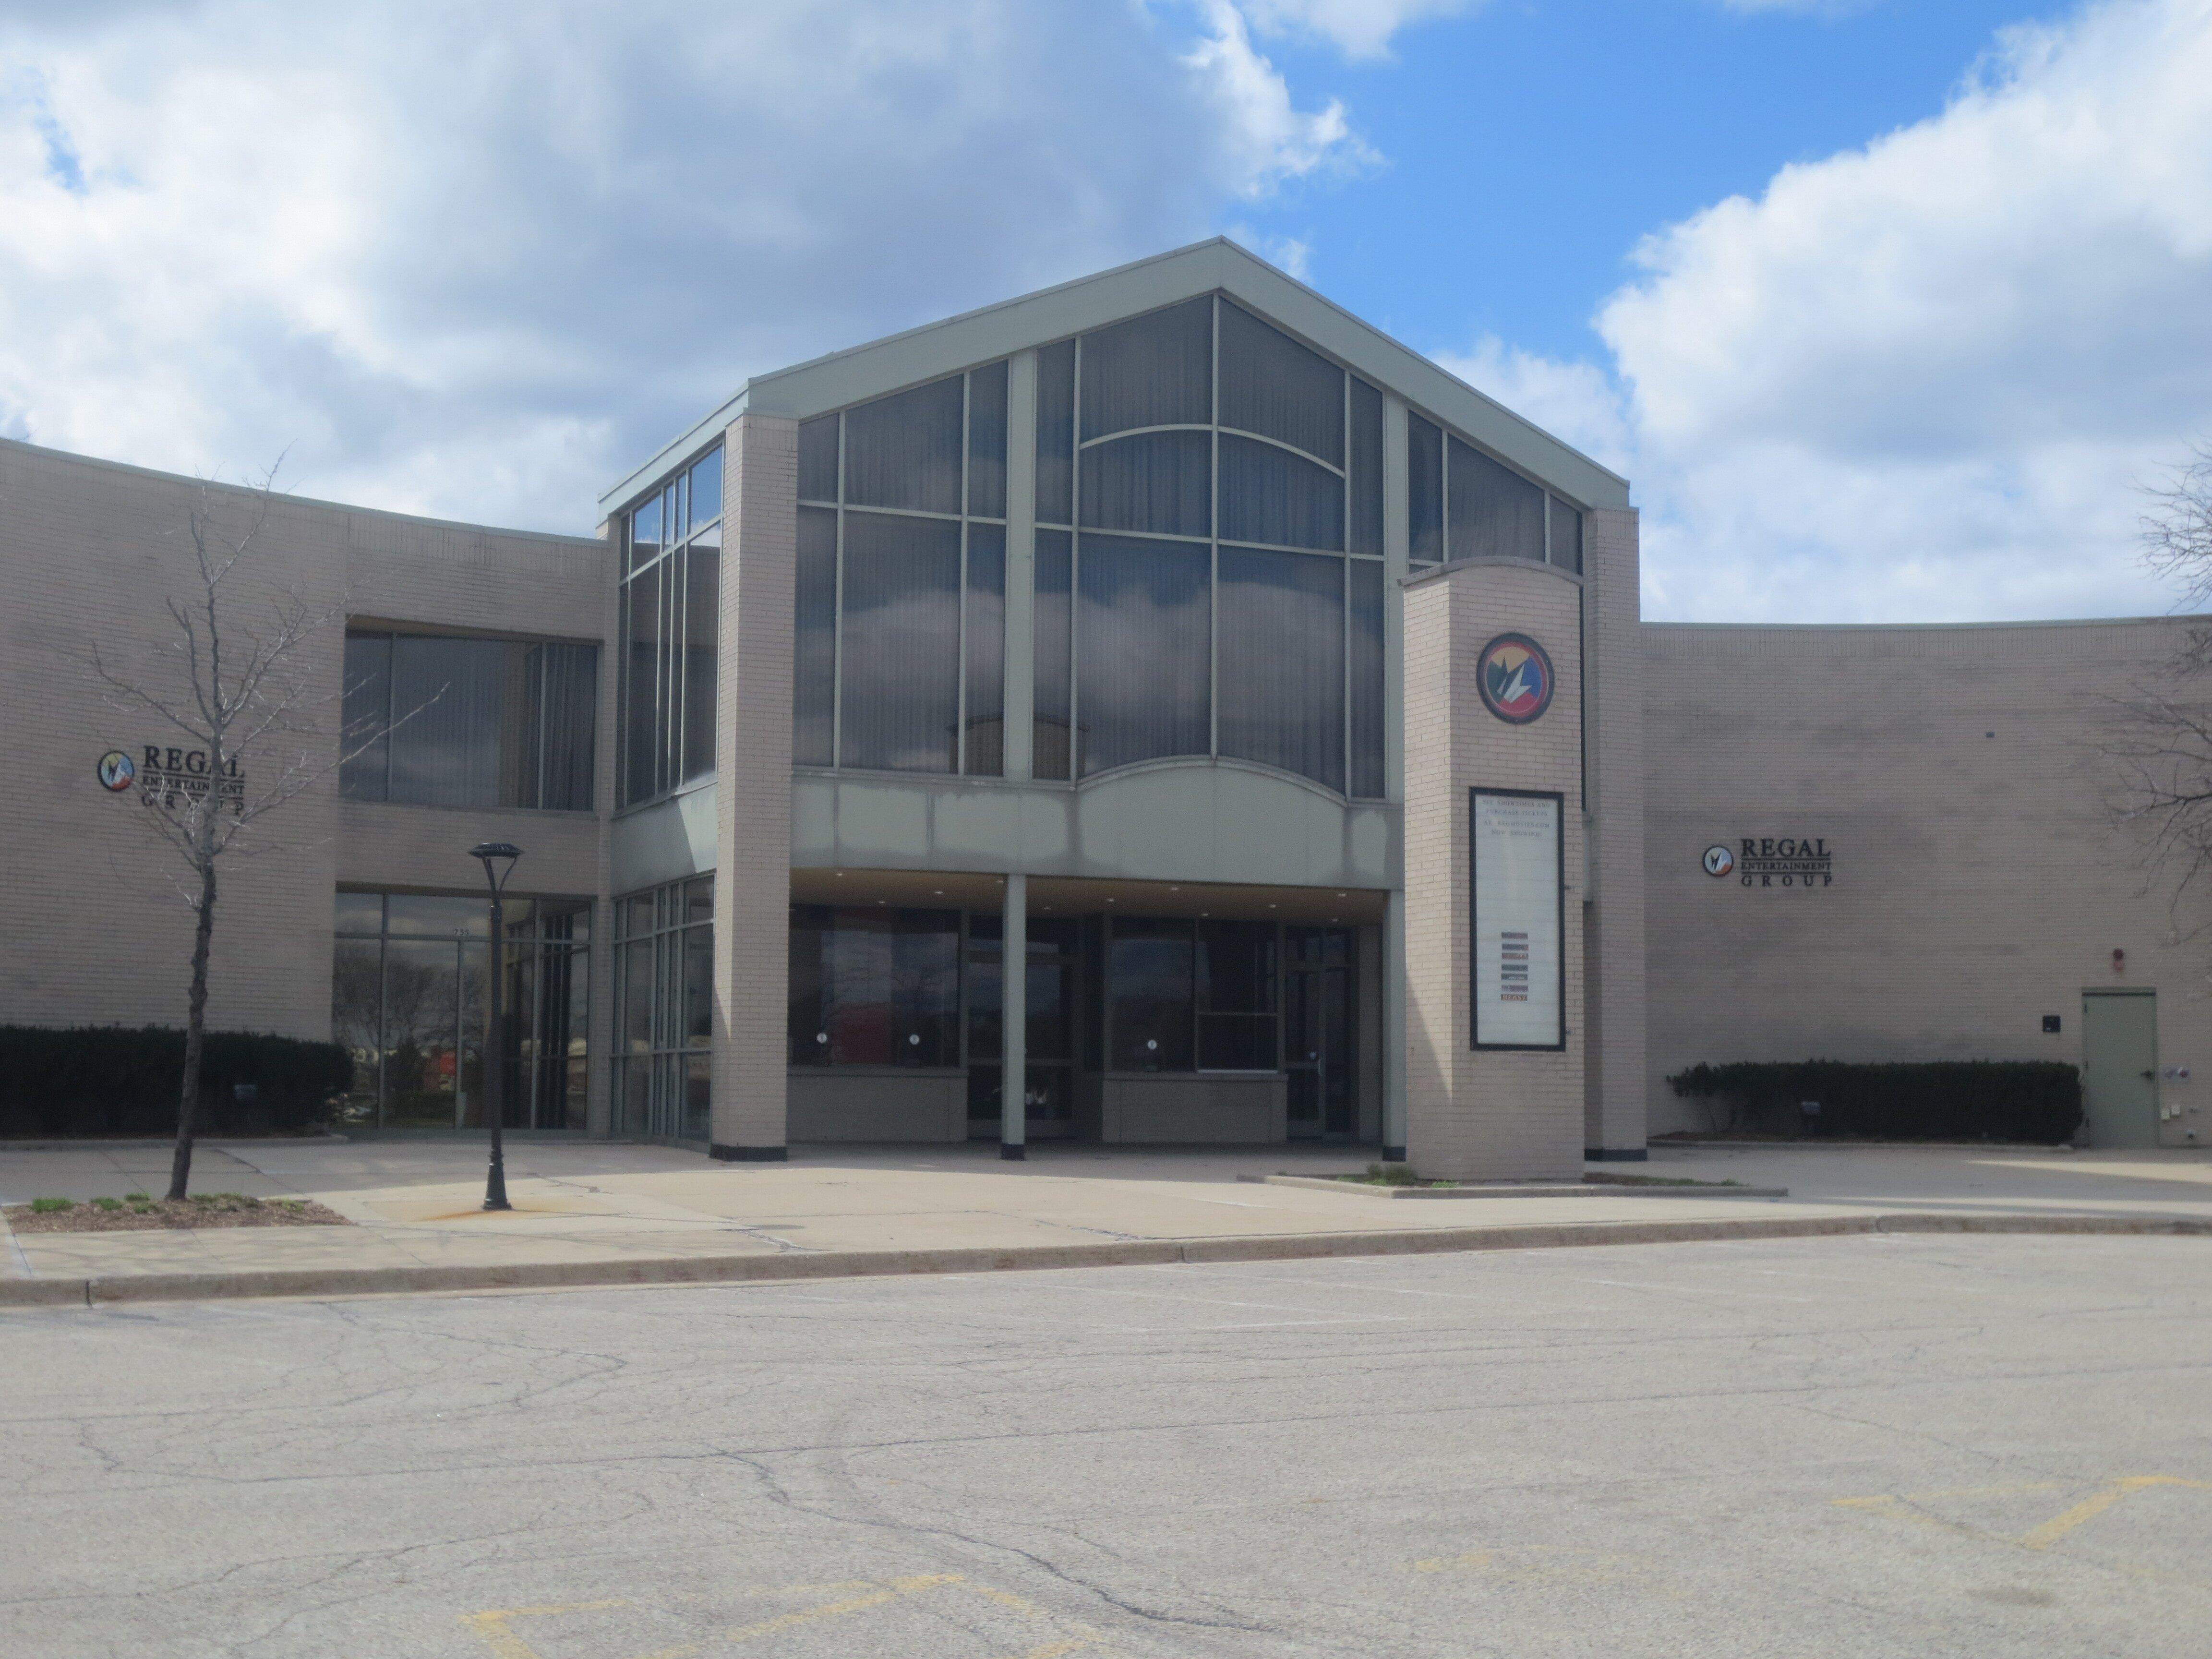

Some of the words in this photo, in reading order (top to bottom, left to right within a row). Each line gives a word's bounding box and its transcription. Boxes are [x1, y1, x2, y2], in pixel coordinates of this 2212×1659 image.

[144, 745, 245, 777] REGL
[143, 776, 245, 794] ENTERTAINENT
[1741, 838, 1831, 857] REGAL
[1741, 862, 1831, 870] ENTERTAINMENT
[1741, 875, 1832, 887] GROUP
